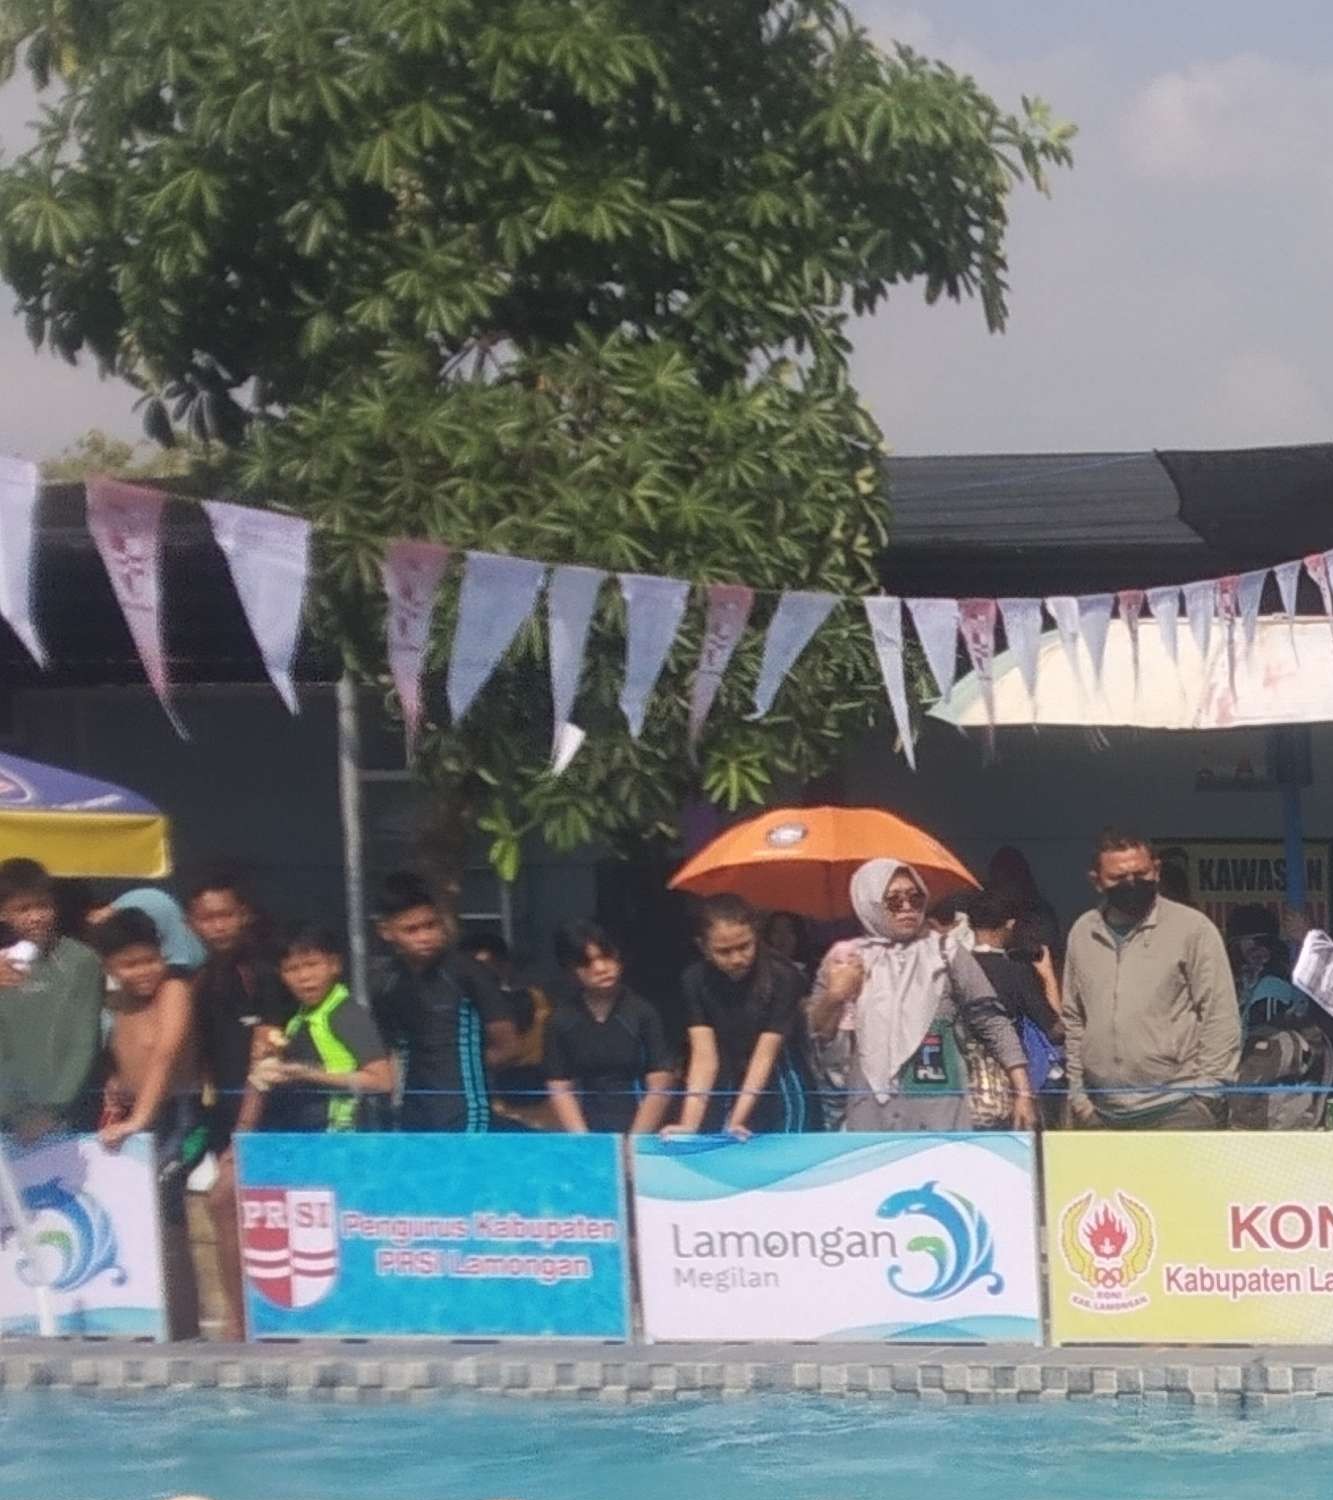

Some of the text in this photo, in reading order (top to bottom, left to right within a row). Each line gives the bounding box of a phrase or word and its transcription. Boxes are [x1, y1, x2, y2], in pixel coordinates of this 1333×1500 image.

[1199, 857, 1323, 892] KAWASN
[241, 1200, 331, 1229] PRSI
[342, 1213, 618, 1248] Pengurus Kabupaten
[672, 1224, 898, 1267] Lamongan
[377, 1249, 591, 1284] PRSI Lamongan
[674, 1267, 780, 1292] Megilan
[1166, 1267, 1301, 1299] Kabupaten
